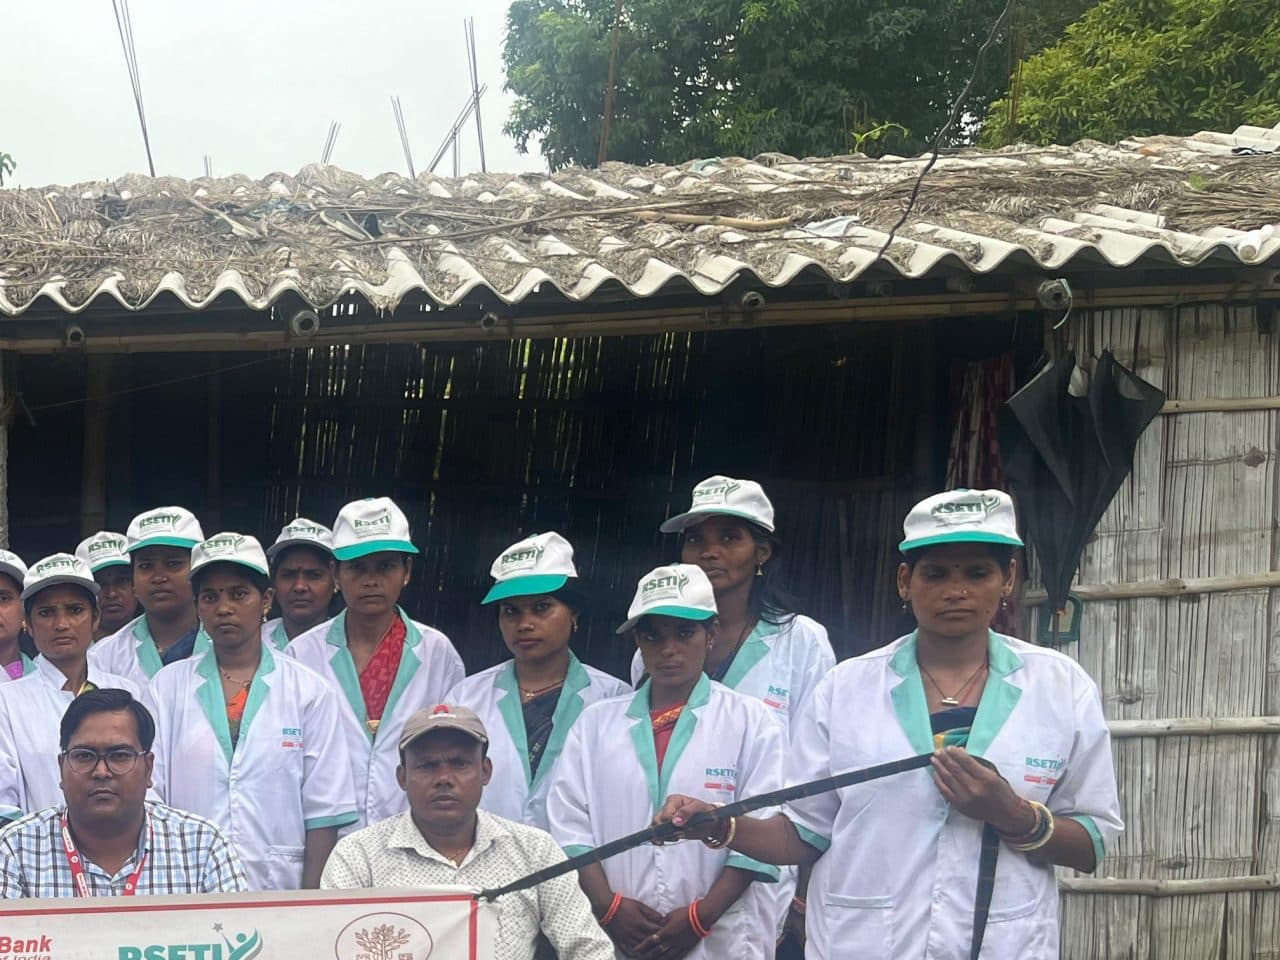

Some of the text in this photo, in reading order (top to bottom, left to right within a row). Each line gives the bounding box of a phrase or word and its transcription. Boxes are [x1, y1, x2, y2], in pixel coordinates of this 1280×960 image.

[930, 502, 982, 515] RSETI
[139, 515, 171, 528] RSETI
[354, 515, 390, 528] RSETI
[88, 540, 117, 553] RSETI
[200, 538, 234, 550] RSETI
[501, 548, 536, 564] RSETI
[36, 560, 72, 573] RSETI
[642, 576, 678, 593] RSETI
[282, 728, 301, 736] RSET
[1025, 757, 1055, 769] RSETI
